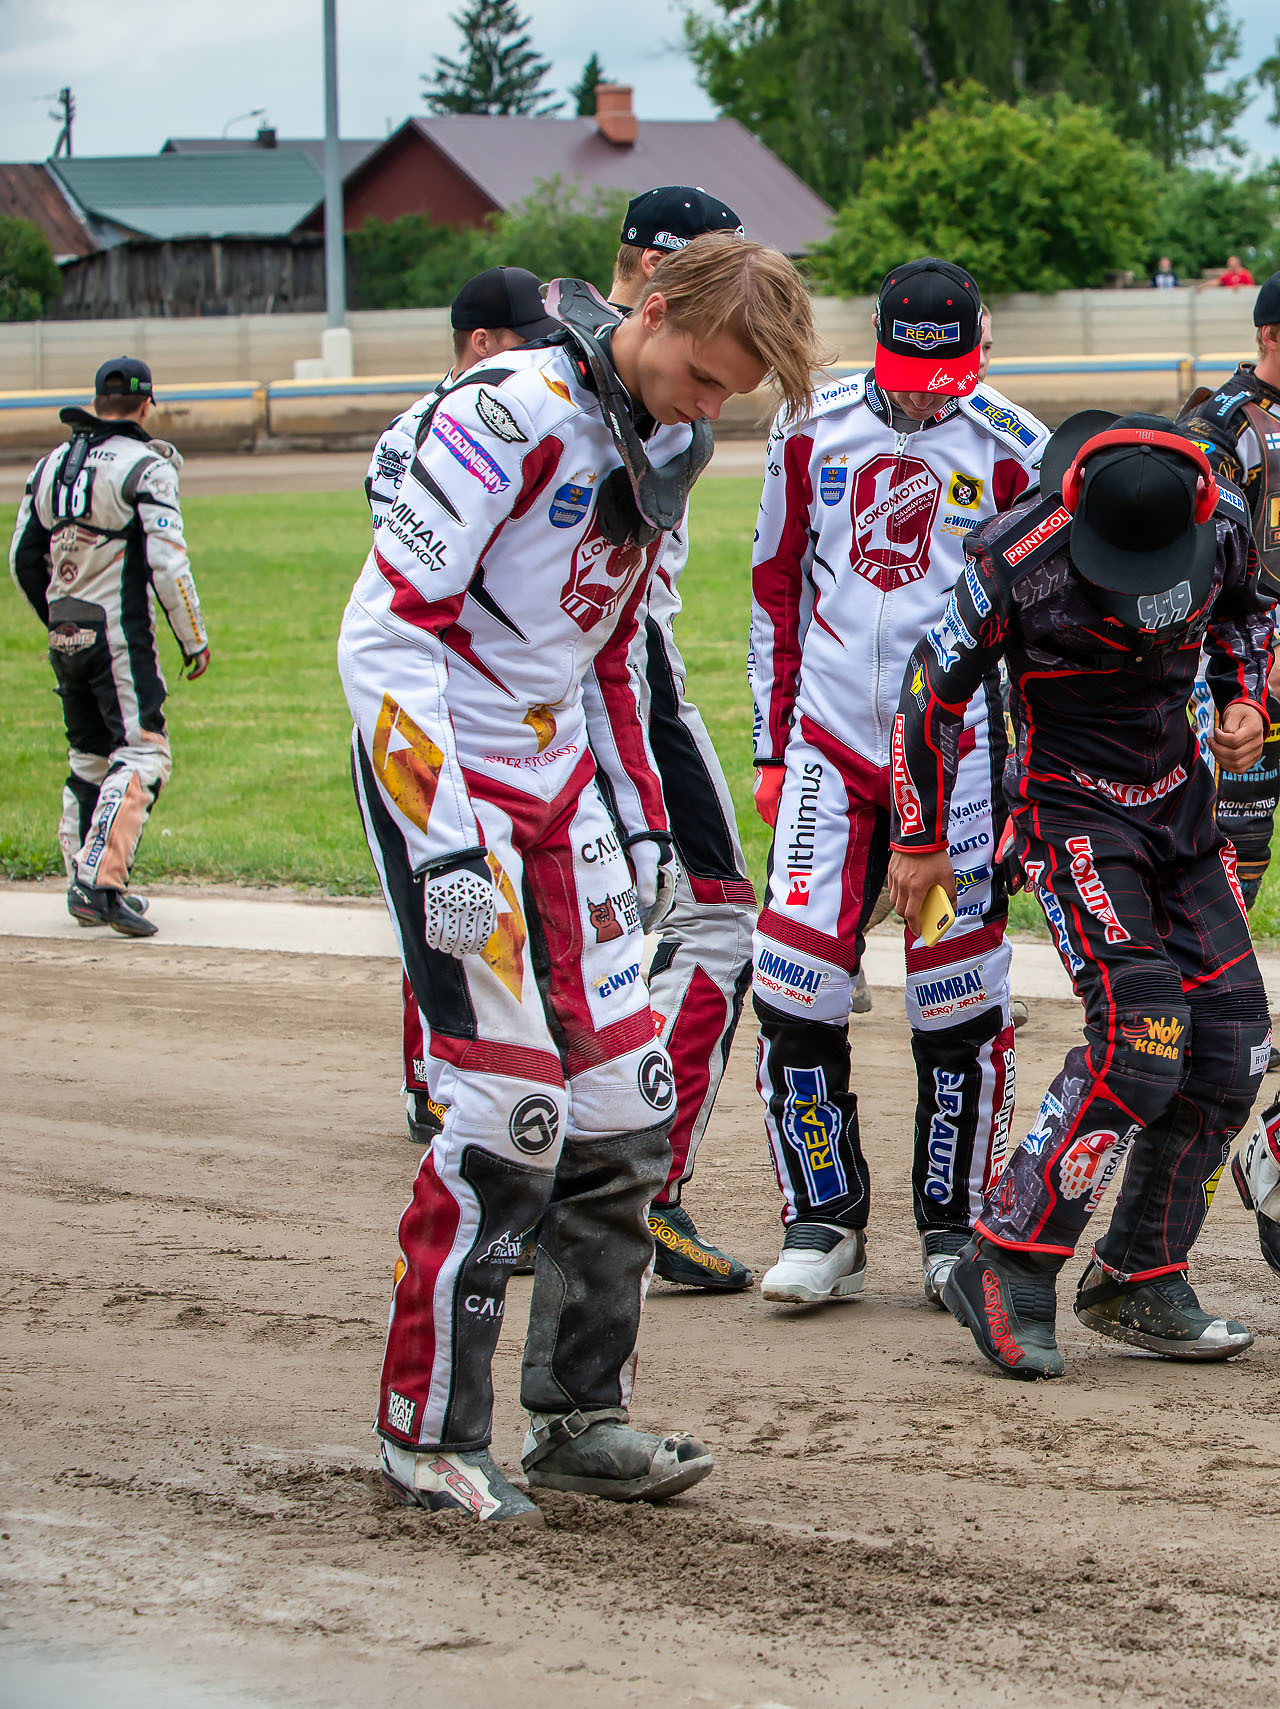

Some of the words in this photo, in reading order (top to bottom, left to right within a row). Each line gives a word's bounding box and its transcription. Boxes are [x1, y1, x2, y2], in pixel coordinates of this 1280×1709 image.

[906, 328, 948, 341] REALL
[821, 383, 858, 401] Value
[983, 406, 1022, 437] REALL
[1136, 430, 1155, 441] JBL
[858, 475, 930, 531] LOKOMOTIV
[1219, 487, 1244, 509] RNER
[384, 513, 441, 571] HUMAKOV
[966, 563, 988, 614] ERNER
[951, 798, 989, 820] Value
[1219, 797, 1276, 809] KONEISTUS
[786, 763, 823, 893] althimus
[949, 832, 989, 859] AUTO
[955, 872, 979, 888] ALL
[758, 948, 822, 994] UMMBA!
[756, 972, 783, 992] ENERGY
[783, 987, 814, 1006] DRINK
[915, 969, 983, 1007] UMMBA!
[921, 1004, 954, 1018] ENERGY
[956, 992, 986, 1008] DRINK
[1135, 1038, 1180, 1060] KEBAB
[926, 1117, 955, 1201] AUTO
[649, 1216, 732, 1277] daytona
[982, 1269, 1027, 1367] daytona
[429, 1455, 494, 1518] TCX
